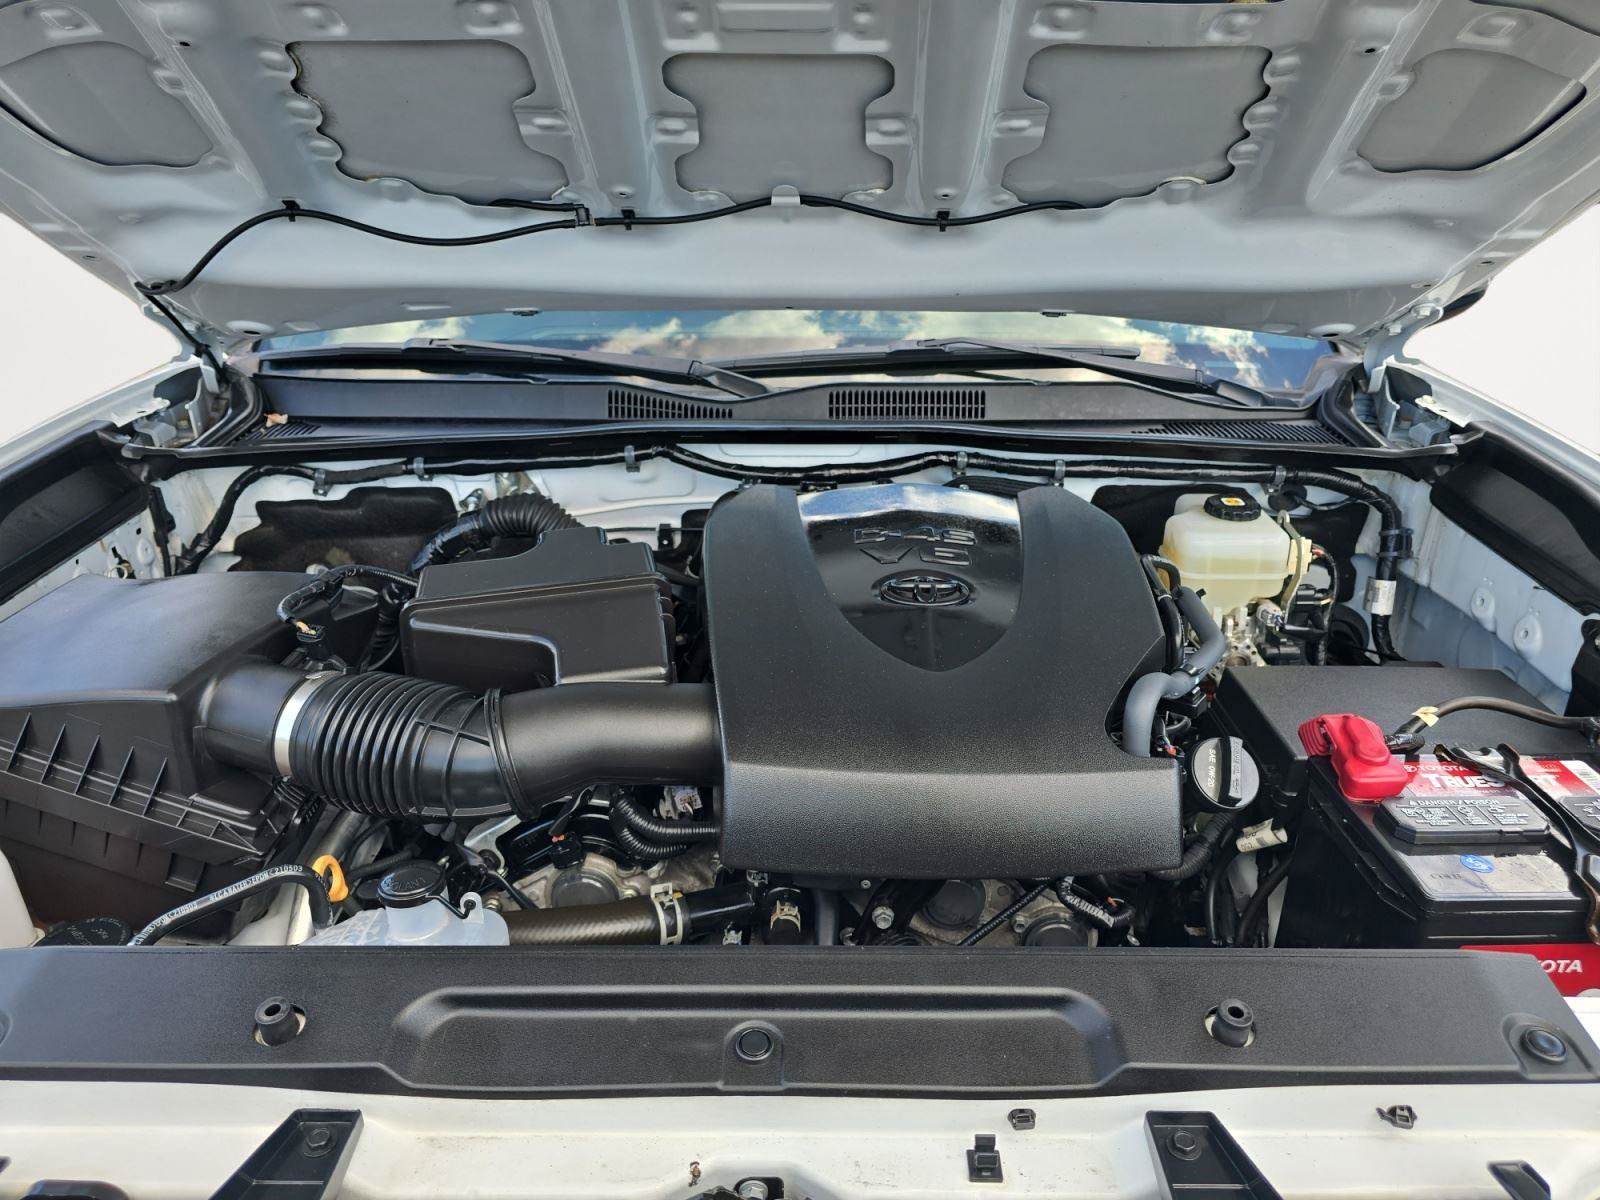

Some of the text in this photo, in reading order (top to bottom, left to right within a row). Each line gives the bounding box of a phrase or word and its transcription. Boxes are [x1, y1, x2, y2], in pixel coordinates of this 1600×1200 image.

[858, 546, 973, 567] V6
[1208, 748, 1217, 763] SAE
[1417, 764, 1470, 773] TOYOTA
